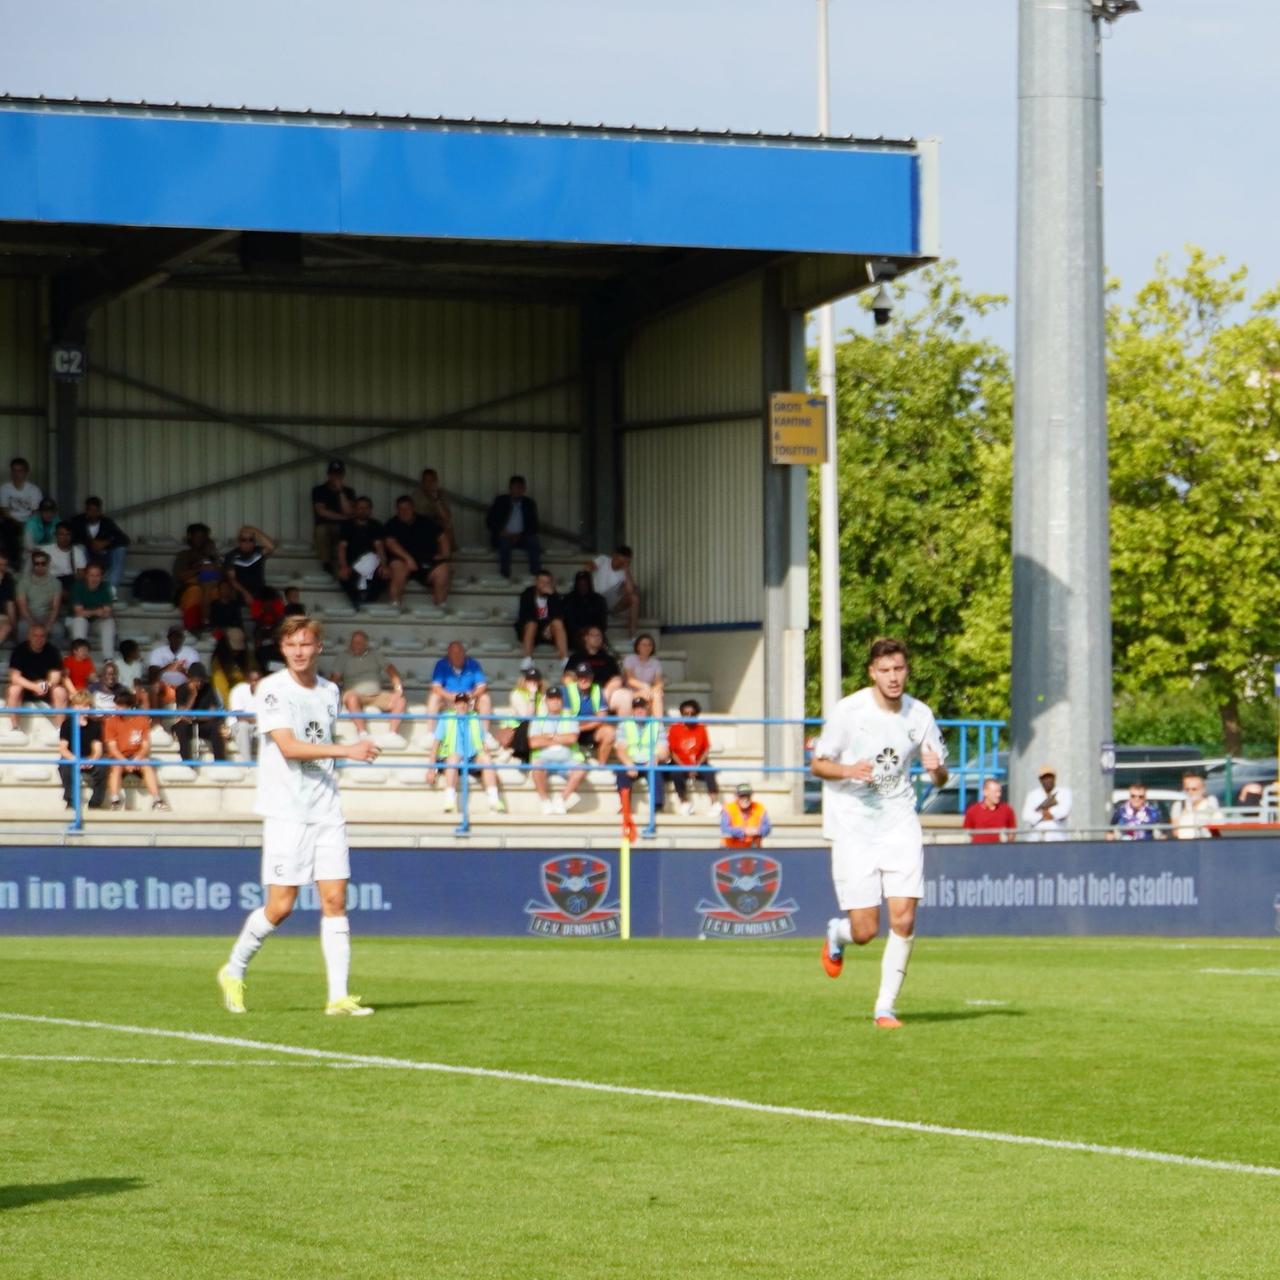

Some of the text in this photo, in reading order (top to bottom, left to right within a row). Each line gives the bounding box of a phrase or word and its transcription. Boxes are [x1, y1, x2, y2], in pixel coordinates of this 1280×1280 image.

[55, 351, 81, 373] C2
[29, 877, 66, 909] in
[75, 877, 138, 909] het
[147, 877, 231, 910] hele
[939, 875, 955, 906] is
[957, 875, 1034, 907] verboden
[1038, 874, 1054, 905] in
[1056, 873, 1085, 906] het
[1088, 873, 1126, 907] hele
[1128, 872, 1198, 906] stadion.
